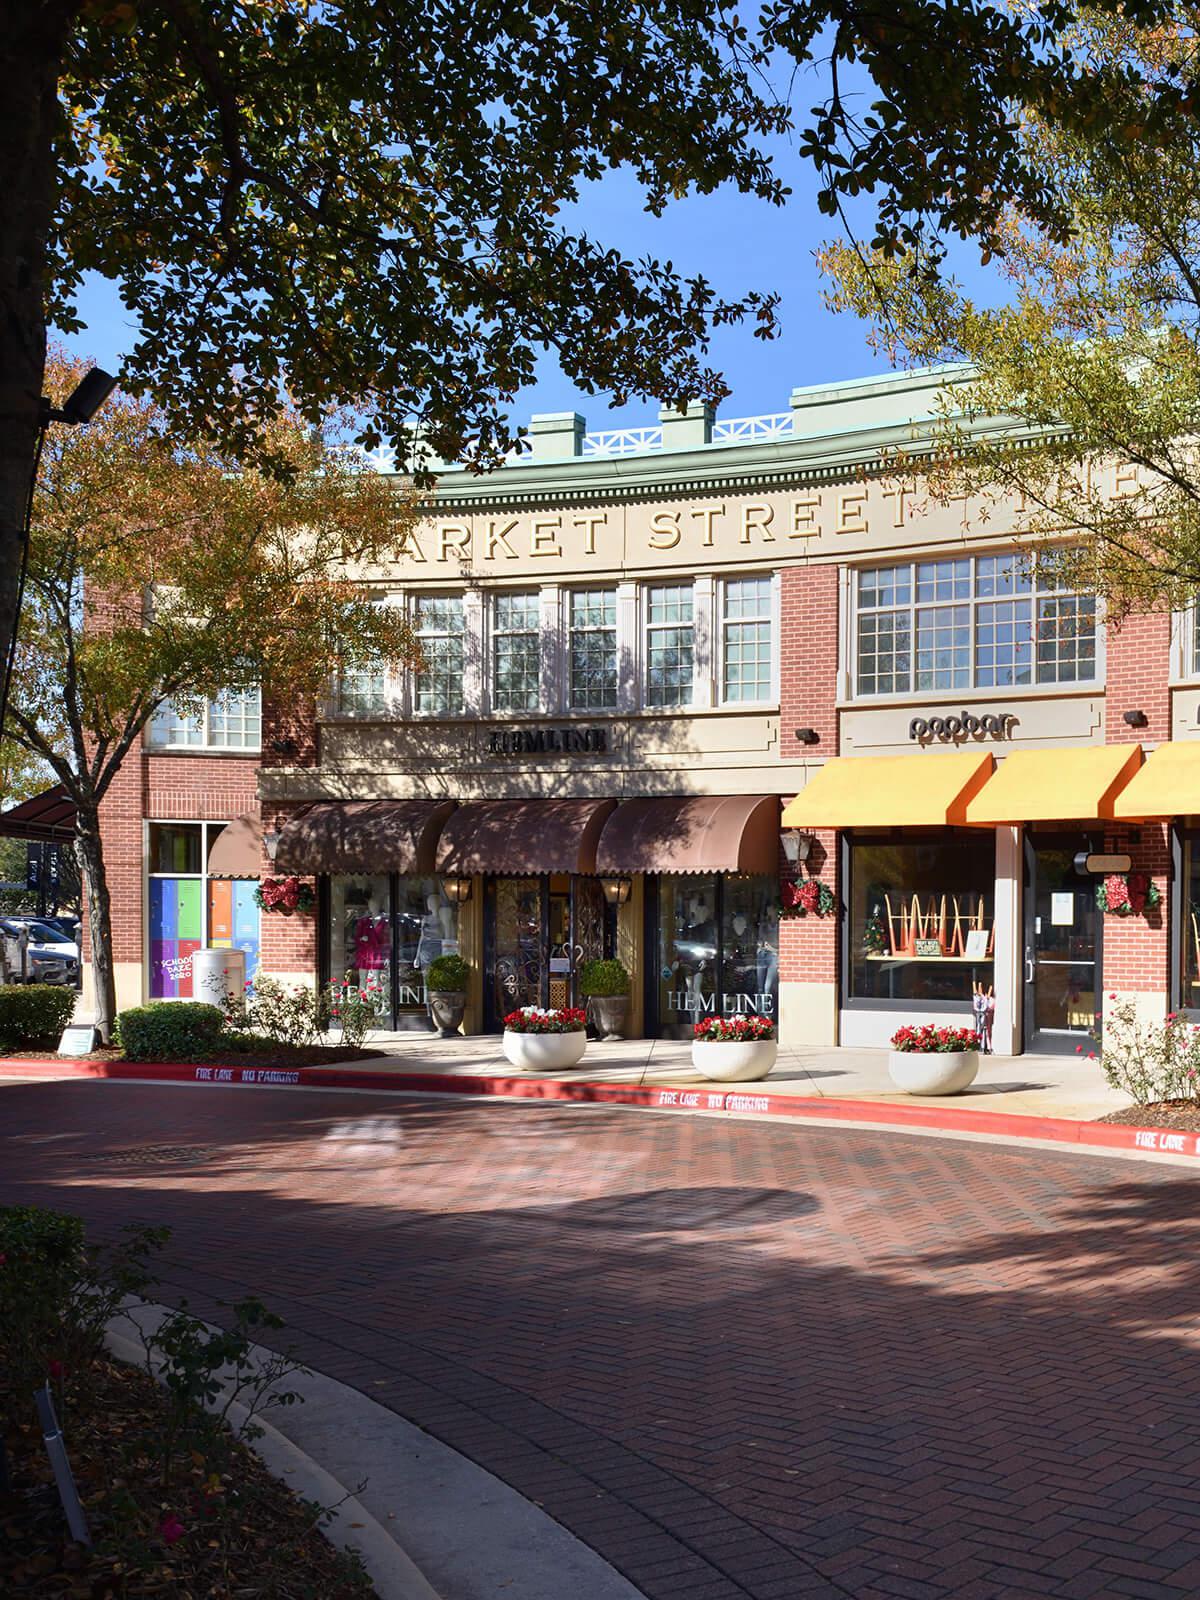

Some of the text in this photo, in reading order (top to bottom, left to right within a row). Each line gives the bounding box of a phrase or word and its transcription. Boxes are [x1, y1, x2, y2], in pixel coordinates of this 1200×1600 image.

[338, 506, 607, 565] ARKET
[648, 480, 917, 549] STREET
[910, 710, 1014, 740] popbar
[242, 1070, 255, 1081] NO
[660, 1091, 769, 1111] FIRE LANE NO PARKING
[1135, 1131, 1157, 1147] FIRE
[1159, 1134, 1186, 1151] LANE
